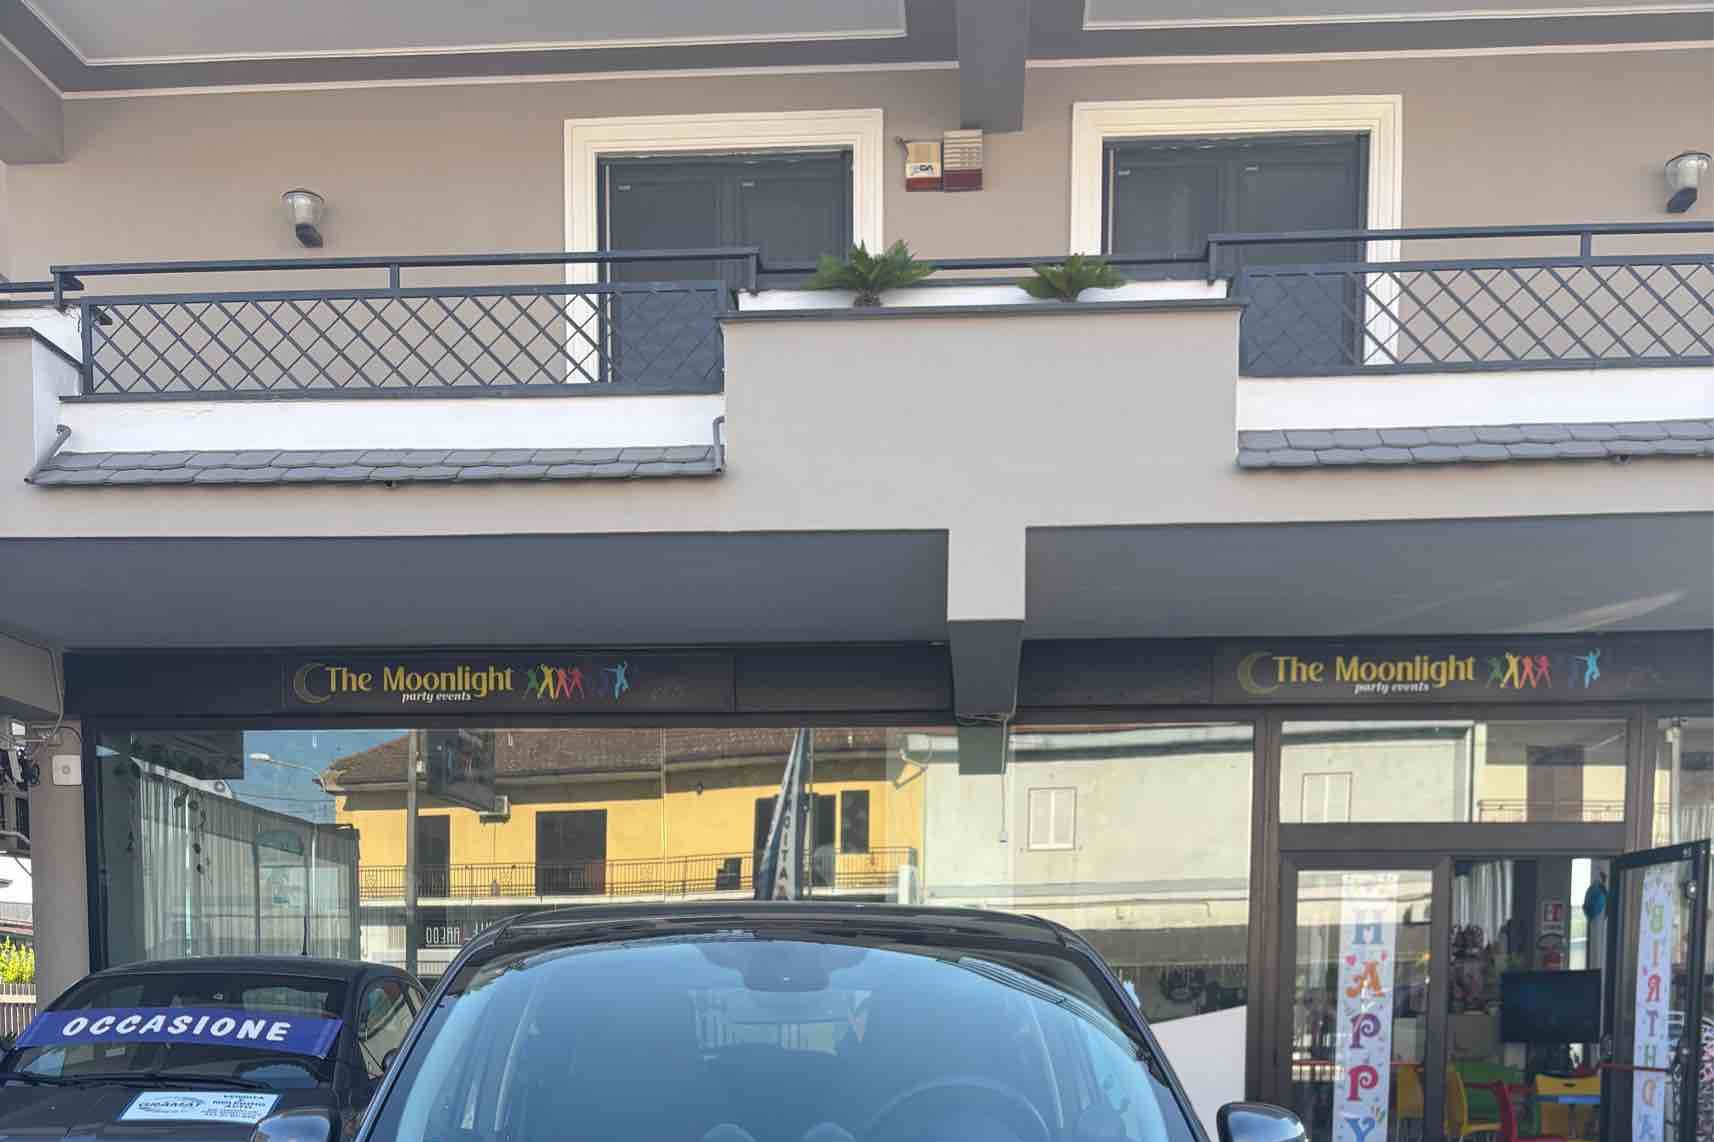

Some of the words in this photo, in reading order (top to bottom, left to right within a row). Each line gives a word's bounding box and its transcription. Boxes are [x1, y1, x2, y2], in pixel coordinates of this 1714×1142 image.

[325, 666, 373, 693] The
[383, 663, 513, 697] Moonlight
[1272, 656, 1324, 682] The
[1335, 655, 1475, 688] Moonlight
[402, 692, 434, 703] party
[436, 692, 472, 701] events
[1354, 682, 1389, 694] party
[1392, 681, 1430, 692] events
[62, 1014, 290, 1042] OCCASIONE
